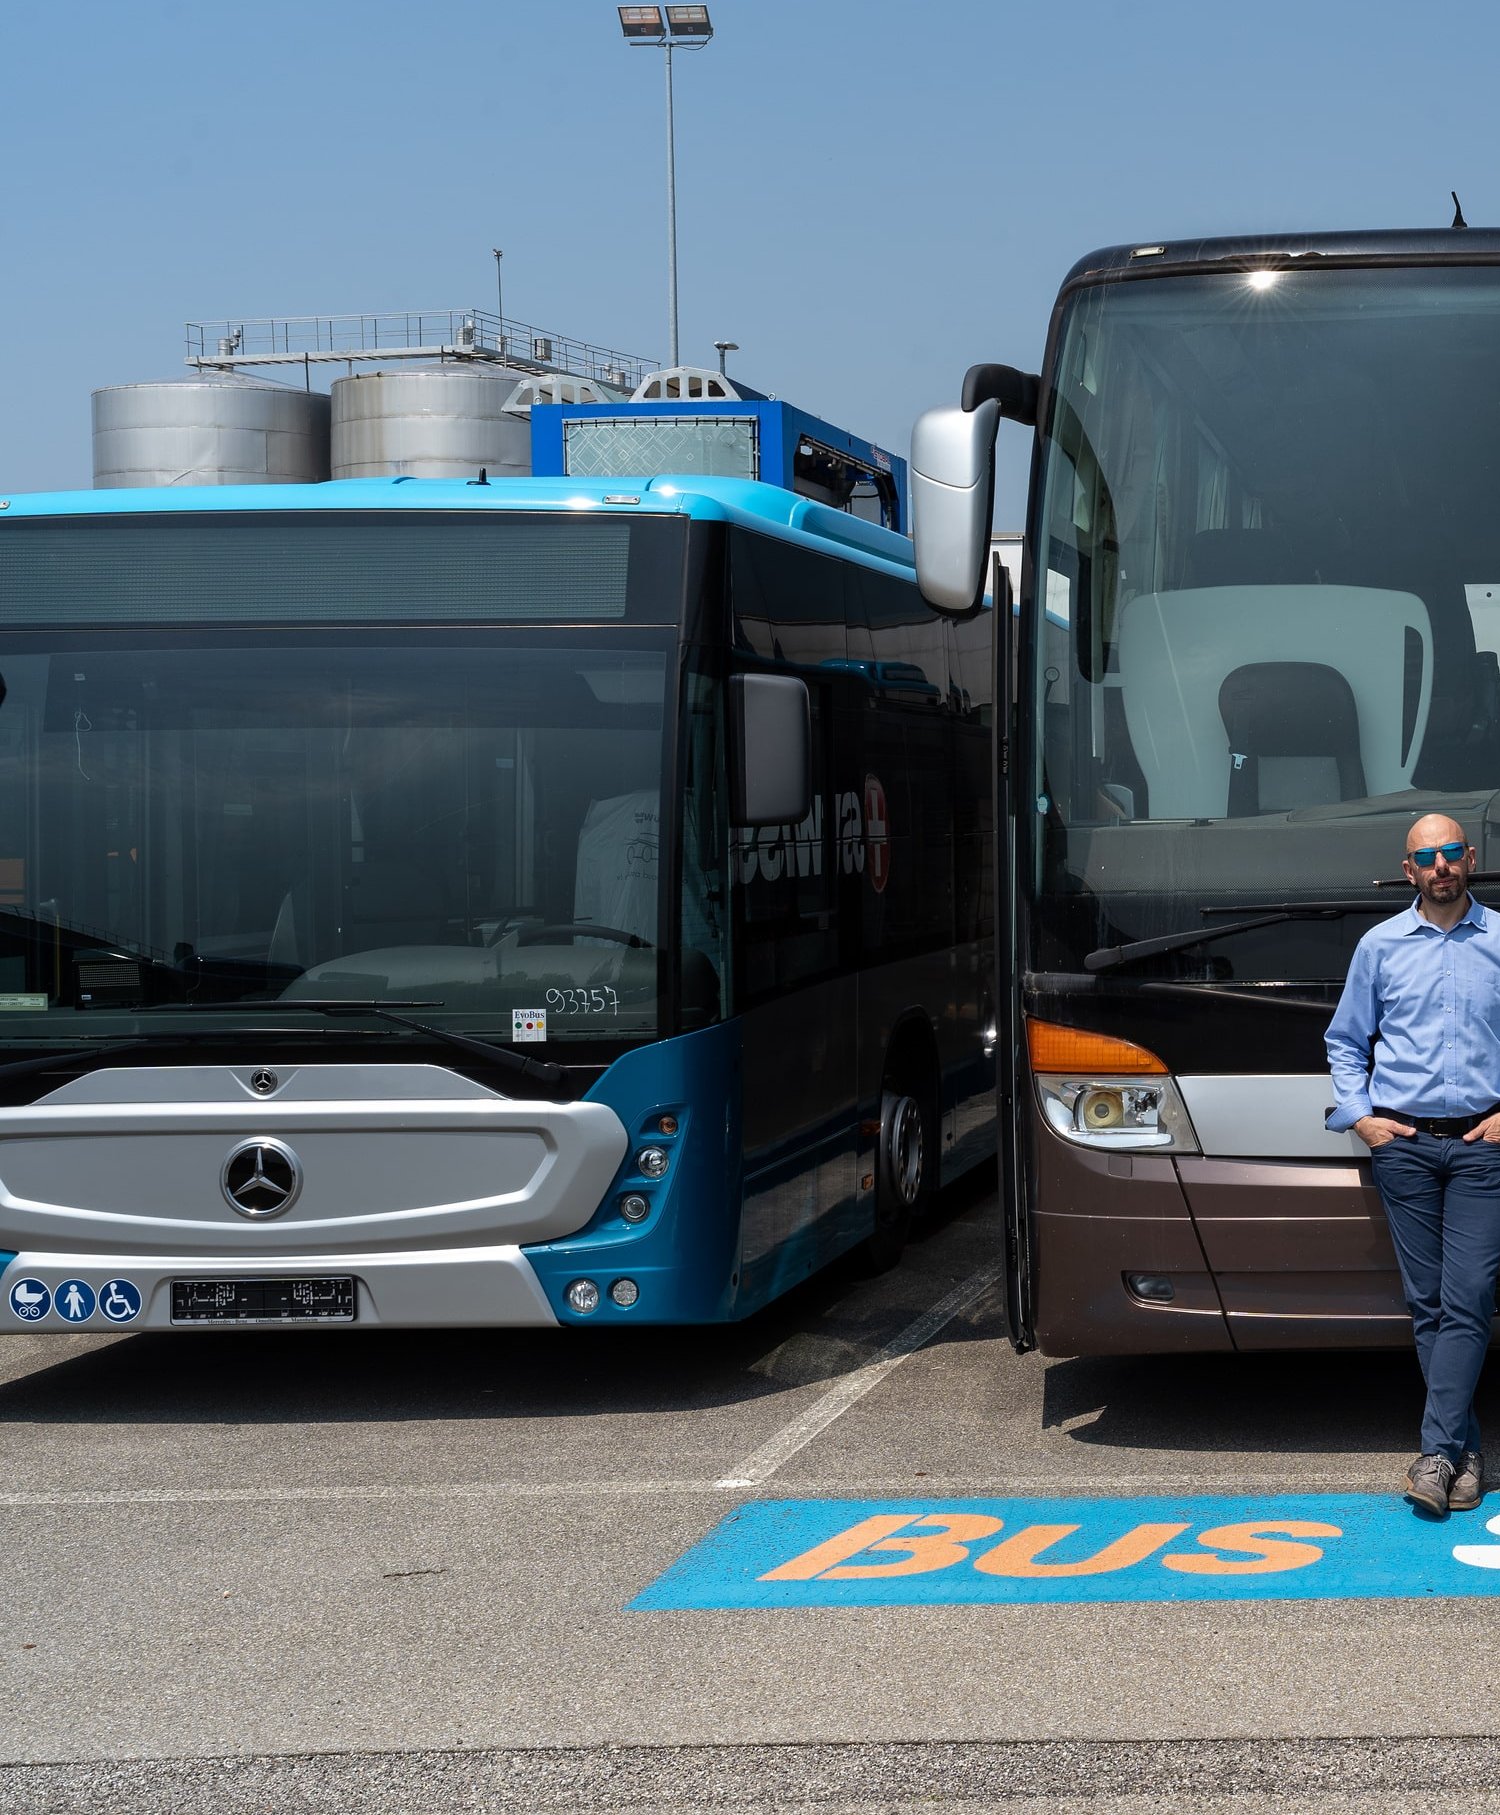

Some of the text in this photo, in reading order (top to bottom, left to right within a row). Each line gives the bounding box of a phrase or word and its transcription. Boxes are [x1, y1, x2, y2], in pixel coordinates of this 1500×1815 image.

[514, 1010, 545, 1019] EvoBus
[545, 985, 621, 1016] 93757
[755, 1513, 1343, 1581] BUS
